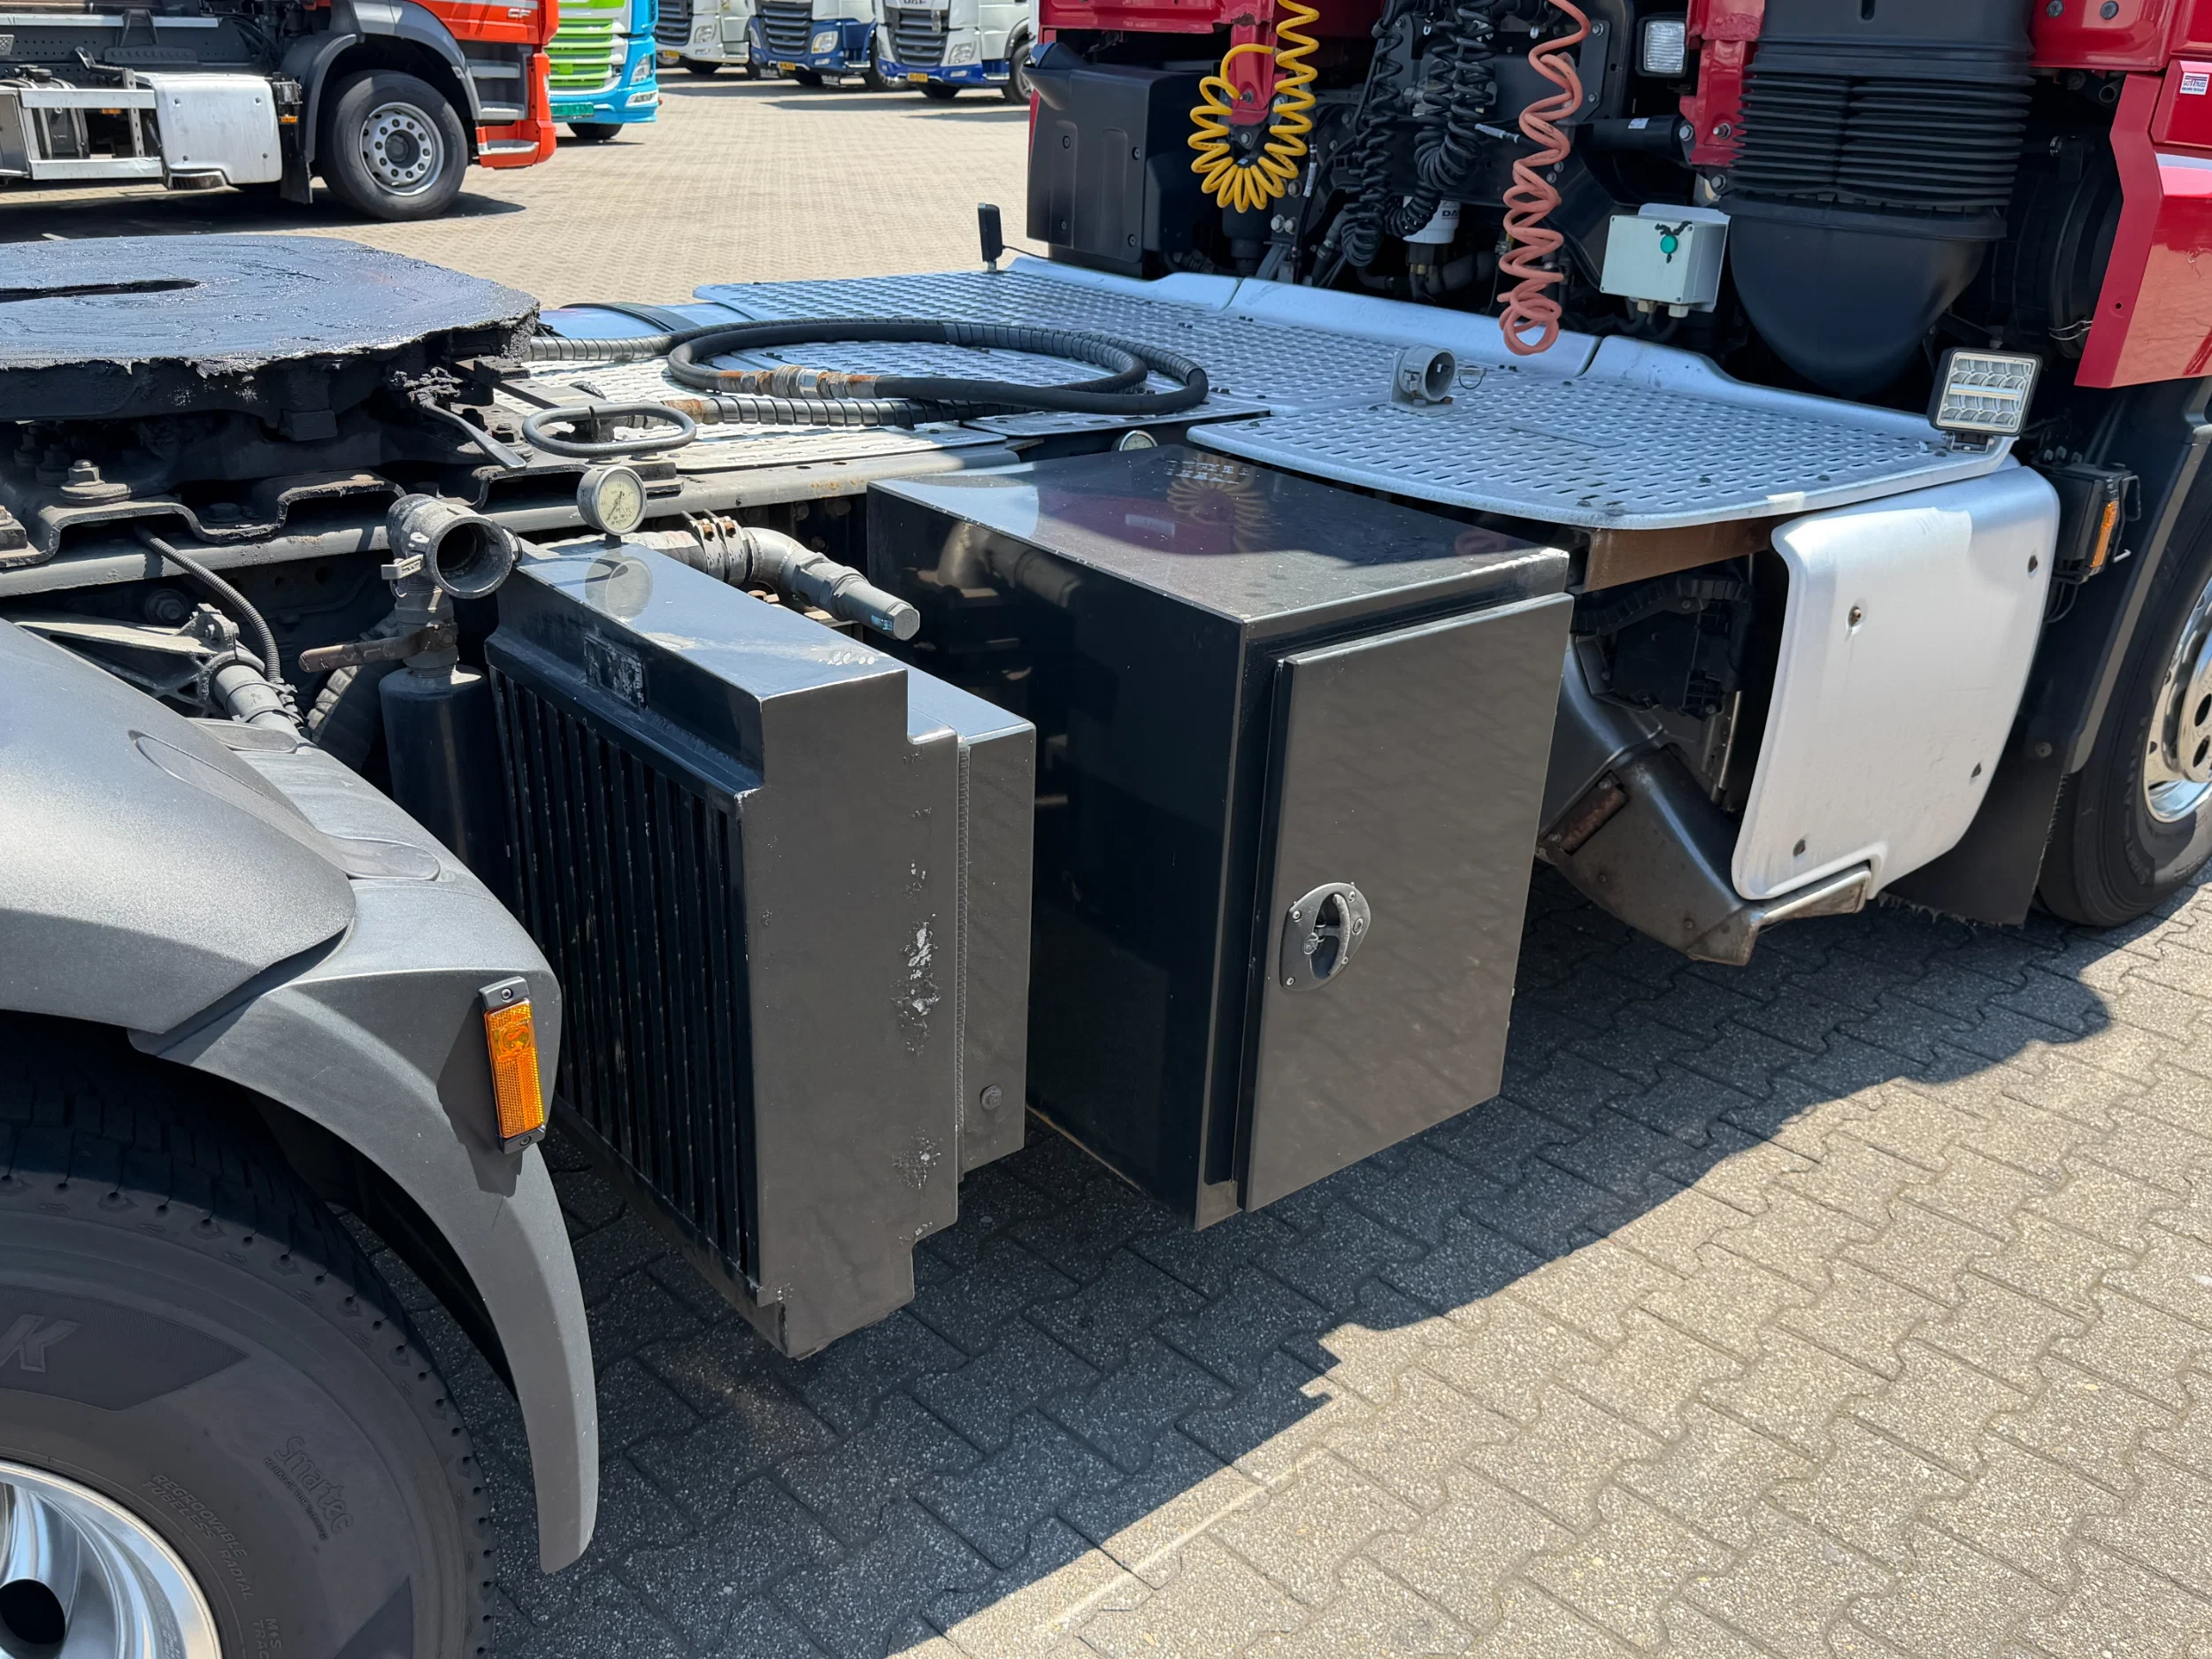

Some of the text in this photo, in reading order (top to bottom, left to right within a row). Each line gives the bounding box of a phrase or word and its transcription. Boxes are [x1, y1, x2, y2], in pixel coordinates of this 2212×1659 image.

[152, 1474, 248, 1558] REGROOVABLE
[273, 1435, 354, 1534] Smartec
[142, 1480, 217, 1540] TUBELESS
[219, 1549, 254, 1601] RADIAL
